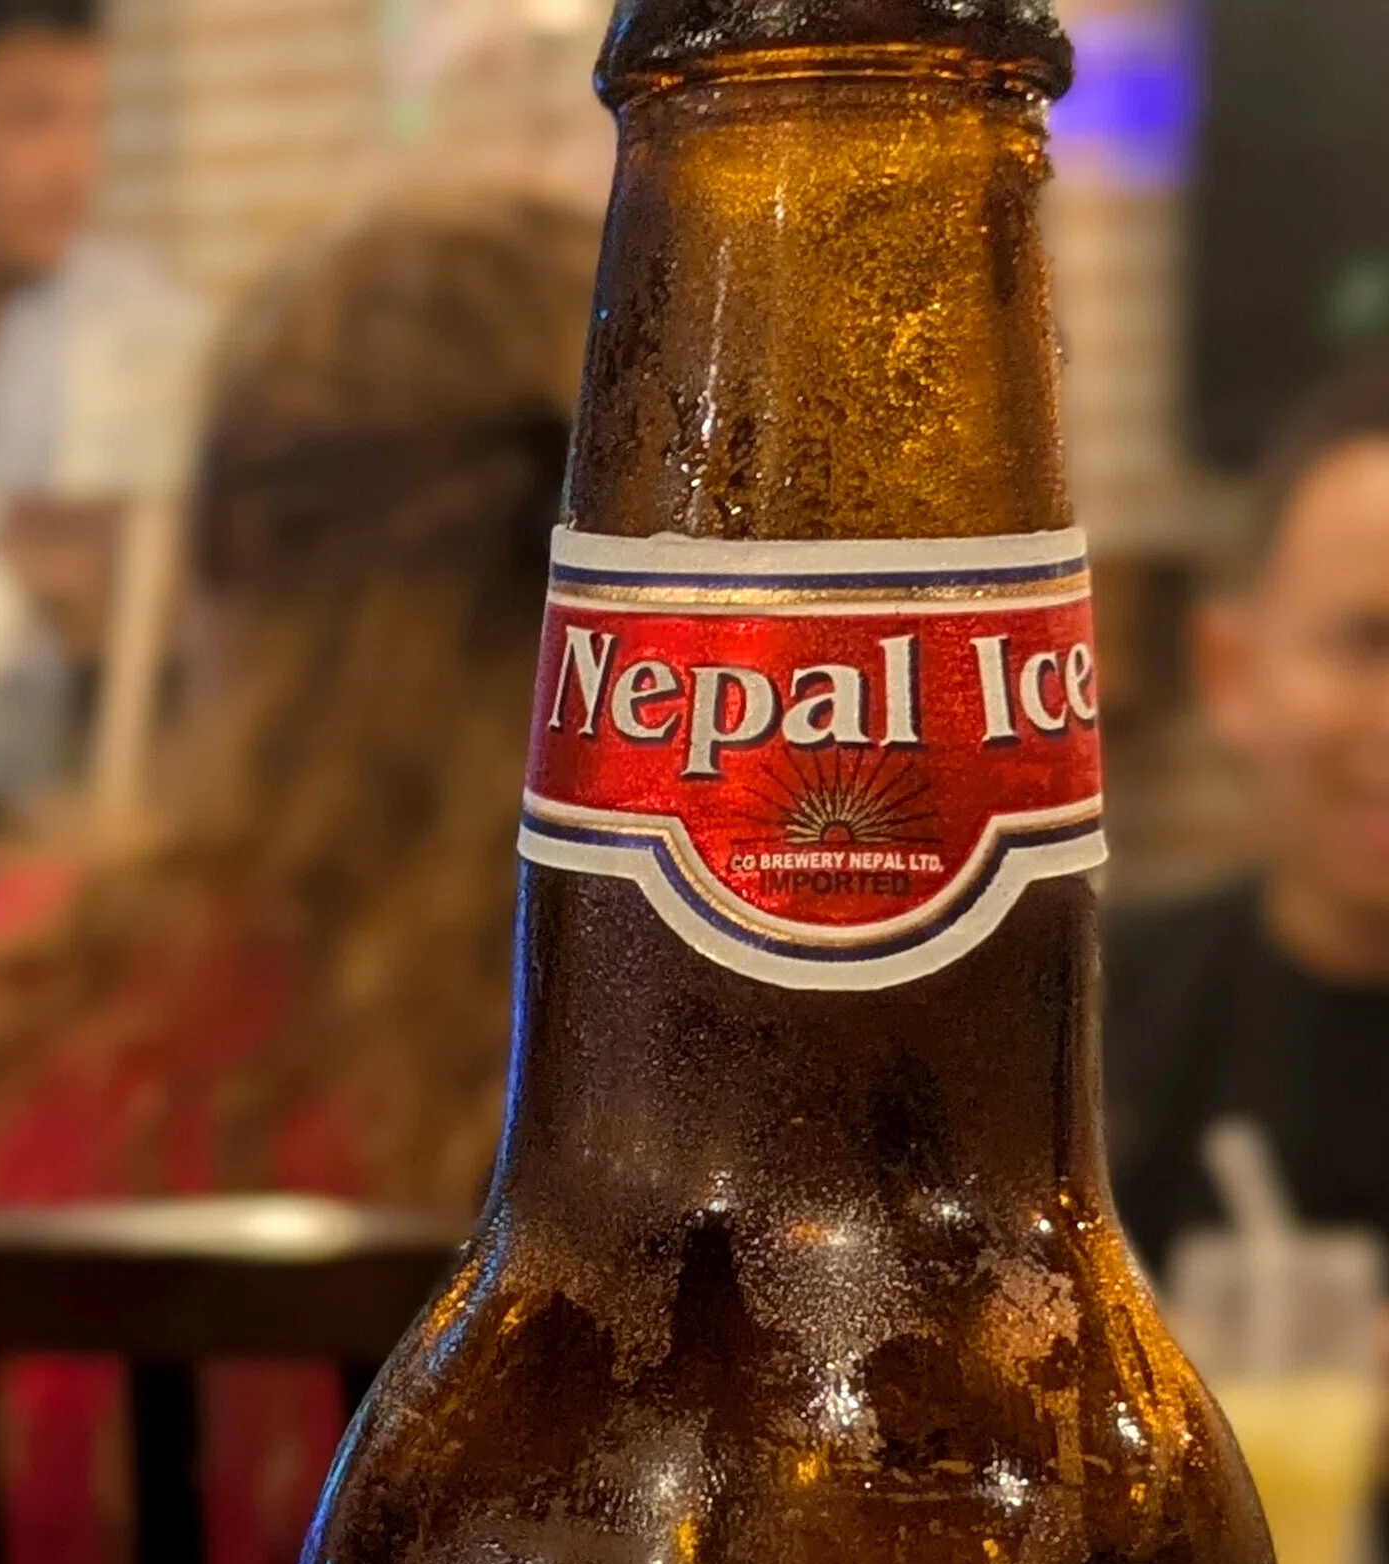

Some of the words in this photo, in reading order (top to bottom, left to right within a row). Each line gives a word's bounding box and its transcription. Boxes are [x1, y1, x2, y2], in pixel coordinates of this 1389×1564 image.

[548, 624, 920, 778] Nepal
[970, 633, 1097, 743] Ice
[730, 853, 757, 871] CG
[759, 851, 844, 870] BREWERY
[849, 852, 906, 871] NEPAL
[761, 871, 911, 897] IMPORTED
